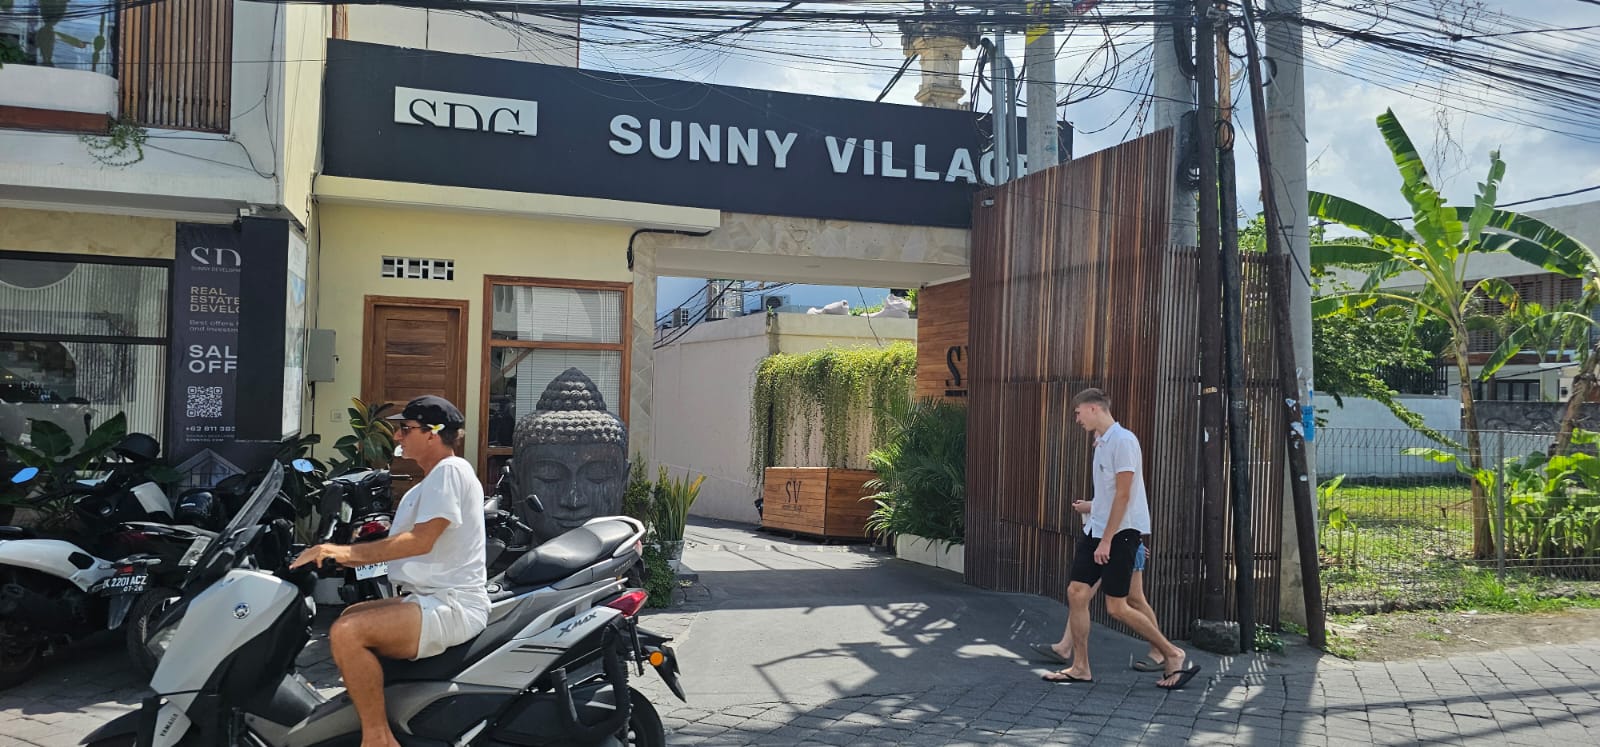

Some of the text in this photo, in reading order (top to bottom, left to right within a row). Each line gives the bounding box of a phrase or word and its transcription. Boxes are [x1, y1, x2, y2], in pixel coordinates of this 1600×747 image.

[608, 114, 798, 168] SUNNY
[190, 286, 227, 296] REAL
[189, 345, 238, 359] SAL
[189, 360, 237, 374] OFF
[785, 480, 801, 504] SV
[111, 577, 129, 587] 2201
[129, 576, 147, 585] ACZ
